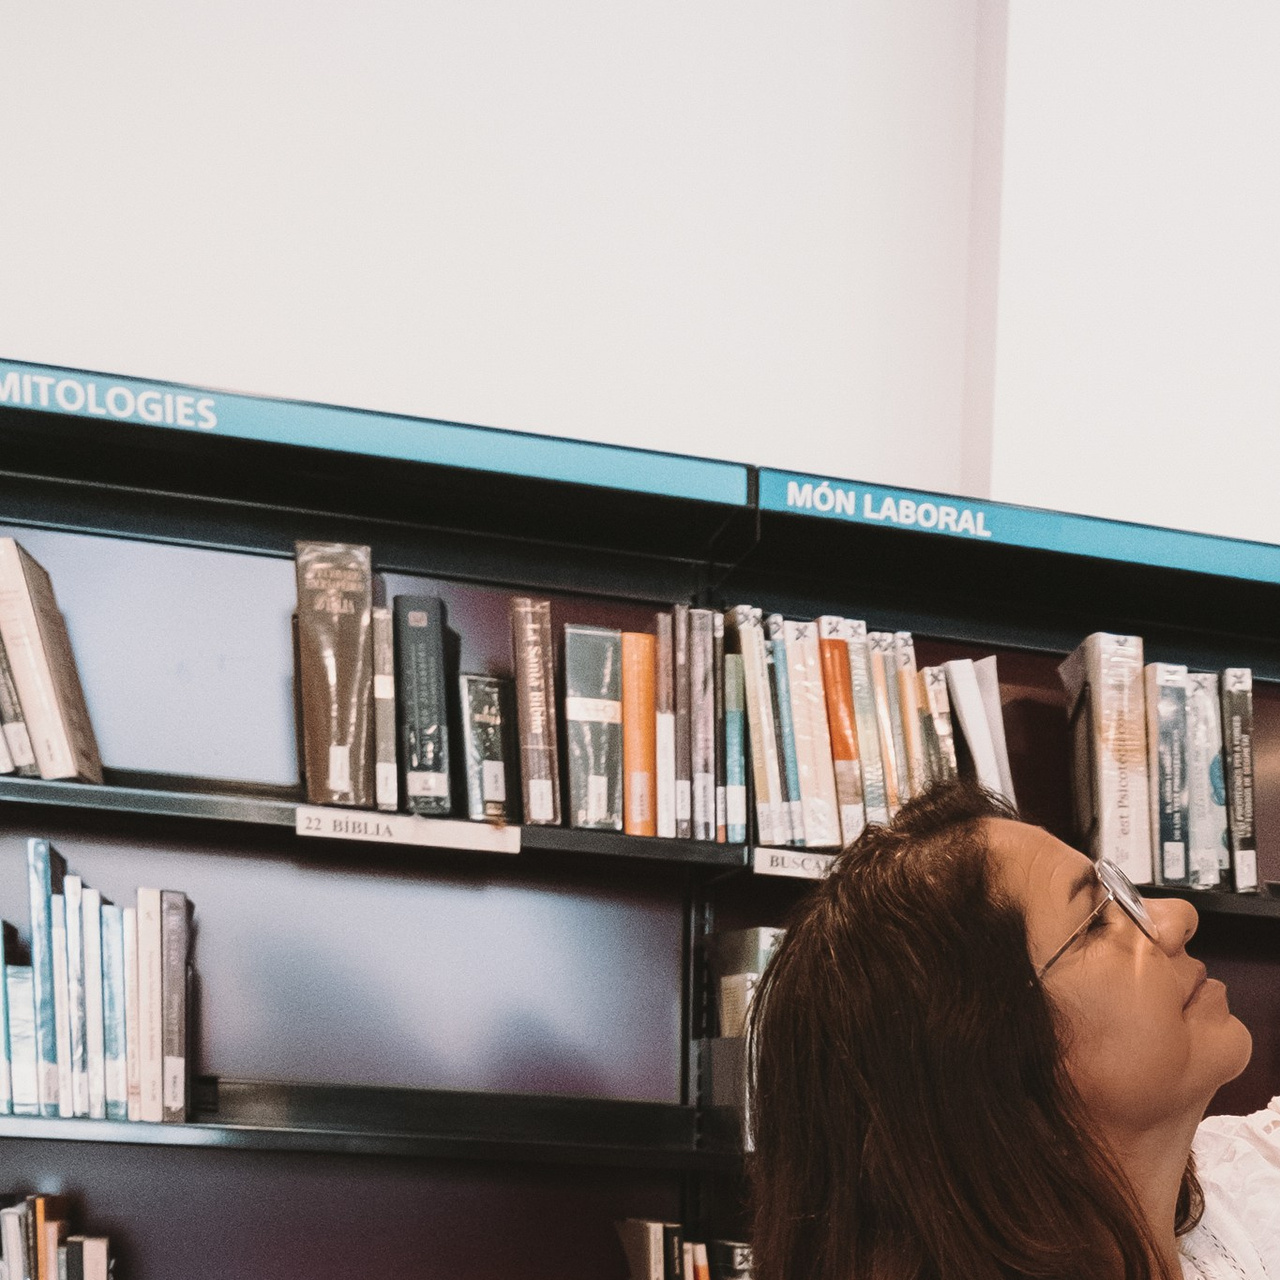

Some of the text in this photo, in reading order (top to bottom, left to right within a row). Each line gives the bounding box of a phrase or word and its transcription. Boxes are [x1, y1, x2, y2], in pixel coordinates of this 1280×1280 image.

[0, 372, 218, 430] MITOLOGIES
[786, 481, 992, 537] MÓN LABORAL
[304, 815, 394, 838] 22 BÍBLIA
